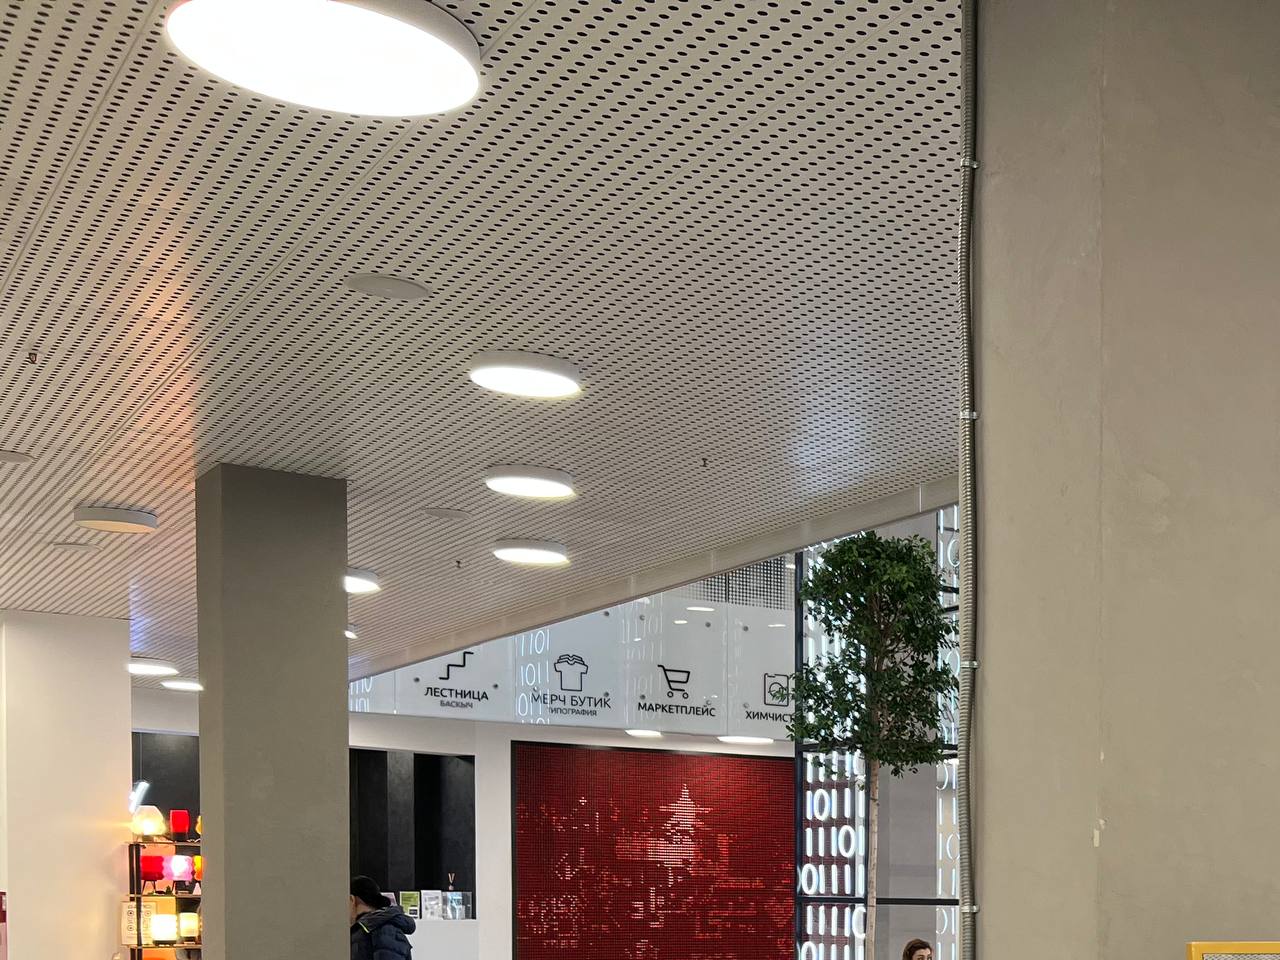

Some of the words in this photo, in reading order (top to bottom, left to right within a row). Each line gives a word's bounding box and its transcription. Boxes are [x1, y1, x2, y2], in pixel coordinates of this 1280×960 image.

[424, 686, 489, 702] ЛЕСТНИЦА
[531, 694, 566, 708] МЕРЧ
[570, 695, 611, 709] БУТИК
[439, 699, 473, 710] БАСКЫЧ
[637, 701, 716, 718] МАРКЕТПЛЕЙС
